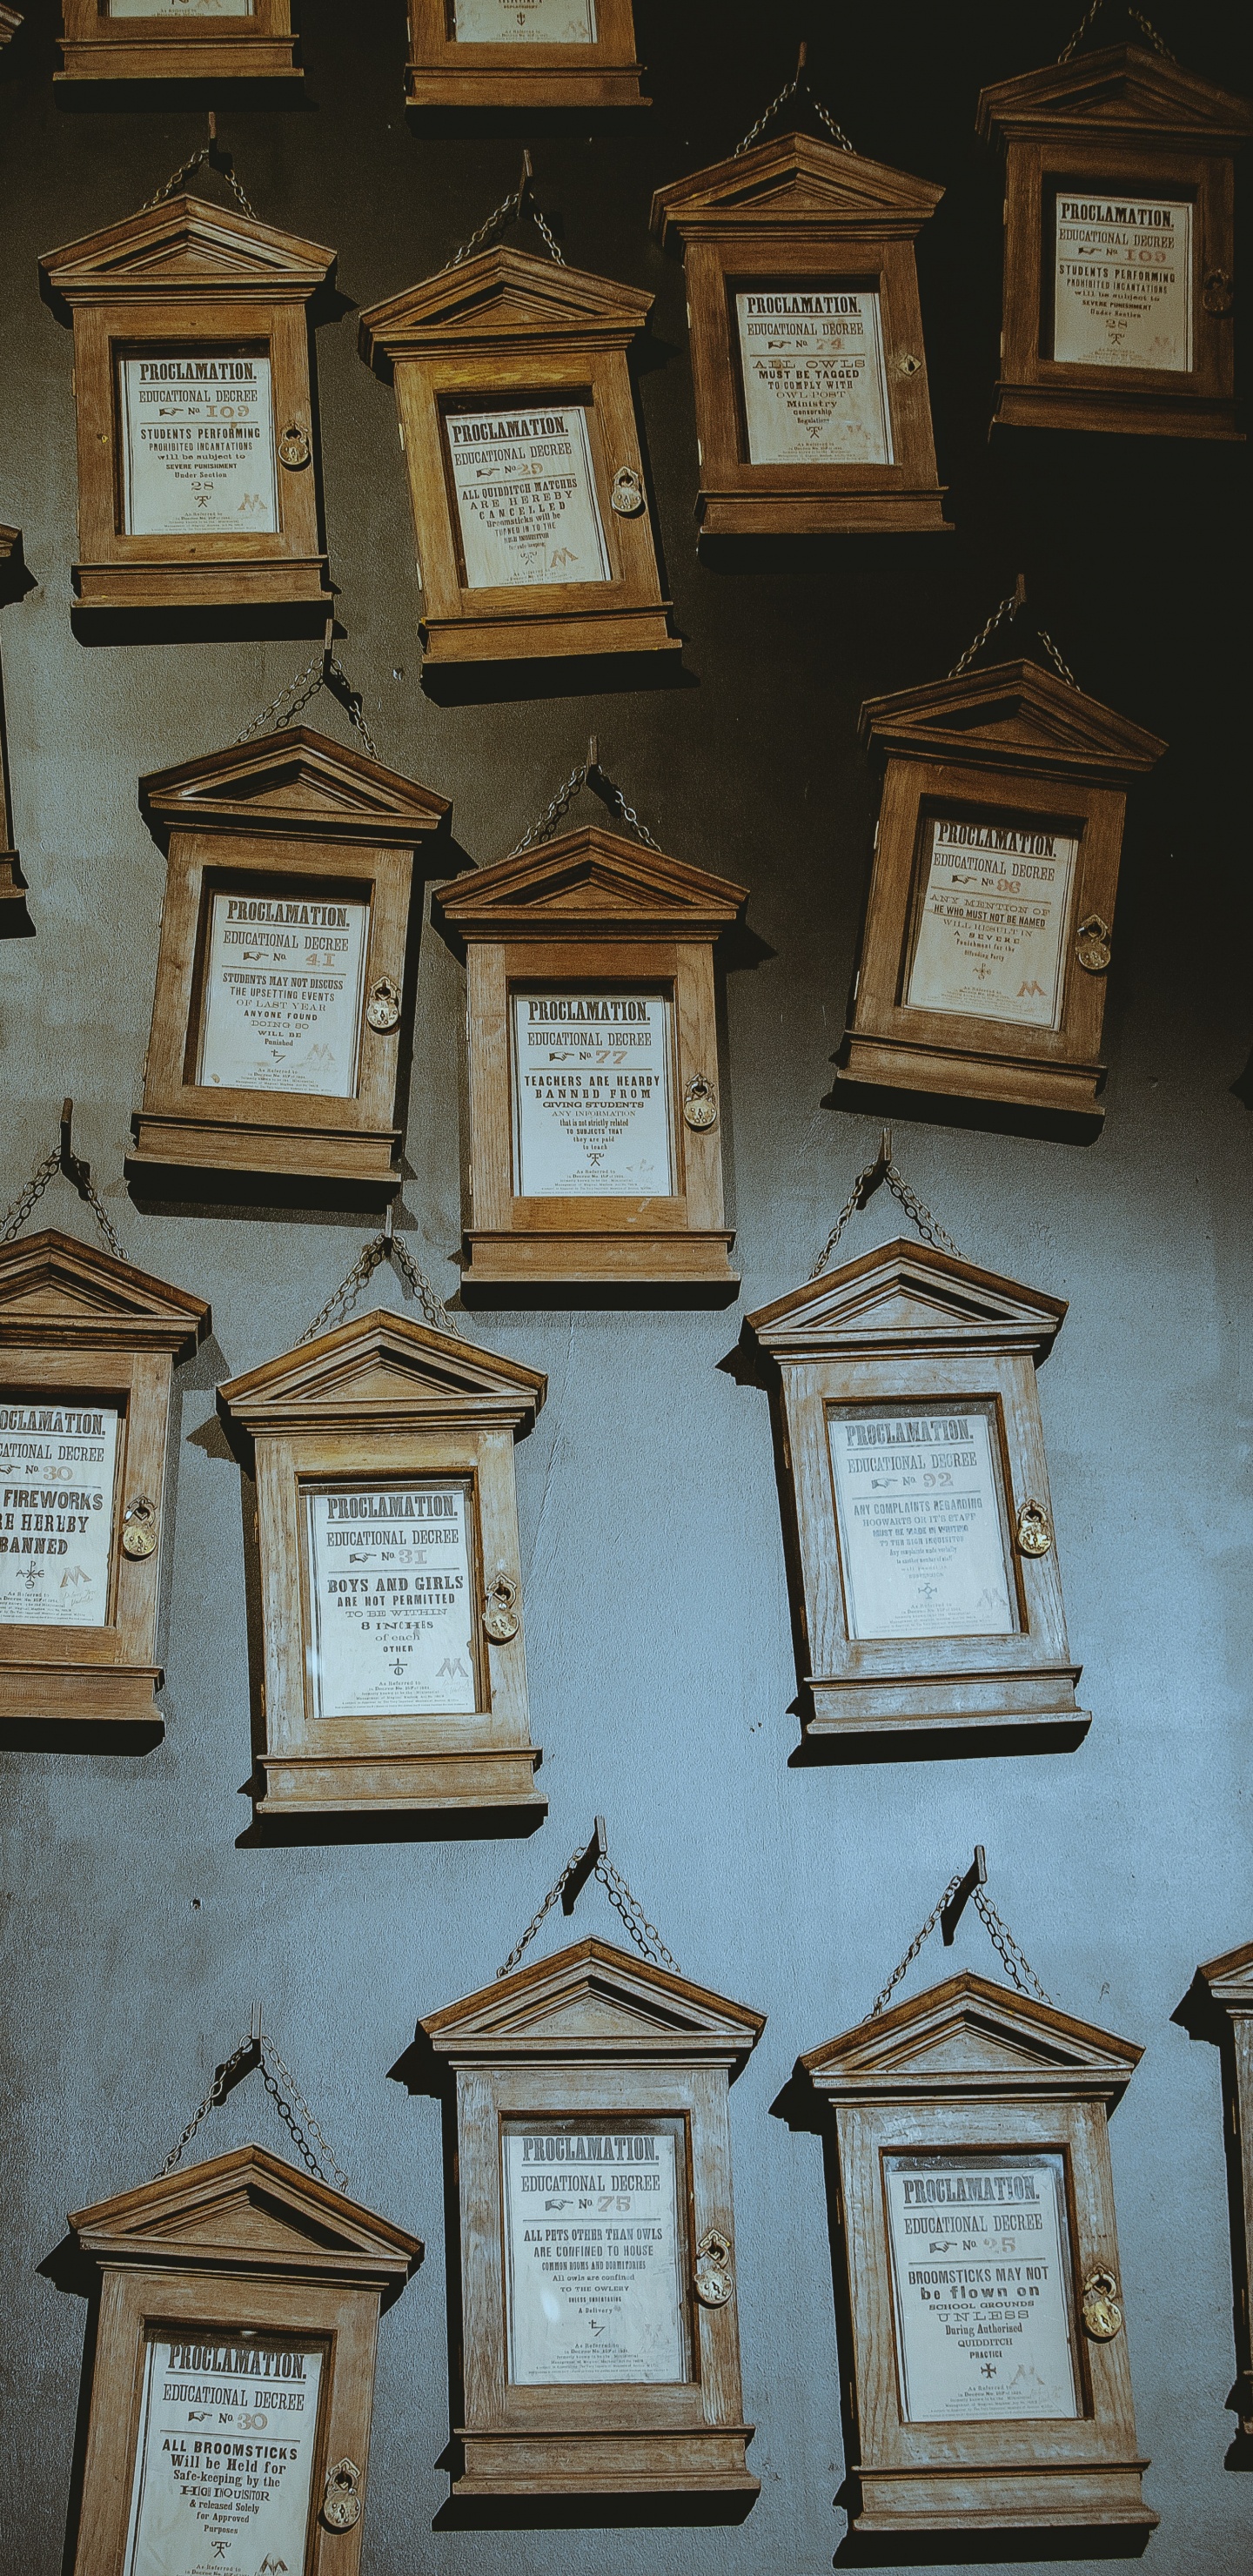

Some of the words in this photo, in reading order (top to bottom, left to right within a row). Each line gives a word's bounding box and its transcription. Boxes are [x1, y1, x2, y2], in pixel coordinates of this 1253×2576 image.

[1061, 202, 1174, 228] PROCLAMATION.
[1059, 228, 1129, 245] EDUCATIONAL
[1134, 234, 1175, 248] DECREE
[1059, 265, 1109, 278] STUDENTS
[1115, 269, 1175, 283] PERFORMING
[747, 297, 861, 313] PROCLAMATION.
[747, 323, 817, 335] EDUCATIONAL
[822, 323, 863, 335] DECREE
[139, 363, 257, 381] PROCLAMATION.
[753, 360, 795, 369] ALL
[806, 359, 865, 368] OWLS
[815, 370, 859, 379] TAGGED
[827, 380, 853, 389] WITH
[138, 391, 211, 403] EDUCATIONAL
[216, 390, 258, 402] DECREE
[141, 429, 191, 439] STUDENTS
[198, 428, 260, 439] PERFORMING
[452, 416, 568, 443] PROCLAMATION.
[149, 443, 193, 452] PROHIBITED
[198, 442, 252, 451] INCANTATIONS
[454, 447, 526, 466] EDUCATIONAL
[530, 443, 572, 458] DECREE
[191, 481, 214, 491] 28
[462, 490, 479, 500] ALL
[482, 484, 531, 499] QUIDDITCH
[534, 479, 578, 492] MATCHES
[471, 500, 499, 510] ARE
[509, 491, 573, 506] HEREBY
[479, 501, 566, 520] CANCELLED
[938, 822, 1056, 857] PROCLAMATION.
[933, 853, 1006, 875] EDUCATIONAL
[1012, 863, 1055, 881] DECREE
[227, 900, 350, 927] PROCLAMATION.
[934, 904, 943, 913] HE
[947, 906, 964, 916] WHO
[966, 909, 987, 919] MUST
[989, 914, 1004, 922] NOT
[1007, 916, 1016, 924] BE
[1019, 916, 1046, 927] NAMED
[224, 930, 298, 949] EDUCATIONAL
[305, 936, 348, 951] DECREE
[223, 973, 267, 985] STUDENTS
[269, 976, 288, 987] MAY
[291, 978, 307, 988] NOT
[310, 979, 344, 990] DISCUSS
[231, 987, 246, 996] THE
[251, 989, 298, 1000] UPSETTING
[302, 992, 335, 1002] EVENTS
[256, 1001, 288, 1010] LAST
[528, 1001, 650, 1021] PROCLAMATION.
[245, 1010, 282, 1019] ANYONE
[527, 1032, 602, 1046] EDUCATIONAL
[608, 1033, 651, 1046] DECREE
[596, 1050, 627, 1064] 77
[525, 1076, 581, 1086] TEACHERS
[589, 1076, 609, 1086] ARE
[617, 1076, 660, 1086] HEARBY
[536, 1090, 600, 1098] BANNED
[610, 1089, 651, 1098] FROM
[588, 1118, 608, 1128] strictly
[0, 1410, 105, 1436] OCLAMATION.
[846, 1419, 973, 1447] PROCLAMATION.
[58, 1446, 104, 1462] DECREE
[847, 1455, 926, 1473] EDUCATIONAL
[930, 1452, 977, 1469] DECREE
[44, 1466, 73, 1480] 30
[3, 1490, 103, 1511] FIREWORKS
[327, 1494, 458, 1519] PROCLAMATION.
[854, 1505, 870, 1516] ANY
[874, 1501, 930, 1515] COMPLAINTS
[863, 1517, 911, 1526] HOGWARTS
[0, 1537, 68, 1555] BANNED
[327, 1531, 406, 1546] EDUCATIONAL
[412, 1530, 459, 1544] DECREE
[328, 1579, 368, 1593] BOYS
[376, 1578, 408, 1591] AND
[415, 1576, 464, 1590] GIRLS
[338, 1597, 358, 1607] ARE
[365, 1596, 385, 1607] NOT
[393, 1594, 455, 1605] PERMITTED
[523, 2137, 660, 2161] PROCLAMATION.
[521, 2175, 605, 2192] EDUCATIONAL
[611, 2175, 660, 2191] DECREE
[903, 2176, 1040, 2204] PROCLAMATION.
[904, 2216, 988, 2234] EDUCATIONAL
[994, 2214, 1042, 2231] DECREE
[524, 2230, 542, 2241] ALL
[546, 2230, 569, 2241] PETS
[572, 2229, 603, 2241] OTHER
[606, 2228, 633, 2240] THAN
[636, 2228, 662, 2240] OWLS
[534, 2246, 552, 2257] ARE
[556, 2246, 603, 2257] CONFINED
[608, 2246, 620, 2256] TO
[624, 2245, 653, 2256] HOUSE
[908, 2268, 991, 2284] BROOMSTICKS
[996, 2268, 1021, 2282] MAY
[1026, 2266, 1049, 2280] NOT
[921, 2287, 940, 2300] be
[950, 2287, 1008, 2298] flown
[1016, 2286, 1040, 2296] on
[937, 2311, 1029, 2322] UNLESS
[945, 2325, 975, 2337] During
[977, 2323, 1022, 2334] Authorised
[957, 2338, 1013, 2347] QUIDDITCH
[168, 2345, 306, 2379] PROCLAMATION.
[163, 2384, 248, 2407] EDUCATIONAL
[254, 2392, 304, 2411] DECREE
[238, 2412, 267, 2430] 30
[162, 2438, 187, 2452] ALL
[194, 2441, 298, 2459] BROOMSTICKS
[171, 2454, 198, 2468] Will
[206, 2456, 220, 2469] be
[227, 2459, 258, 2472] Held
[265, 2461, 285, 2475] for
[174, 2470, 242, 2487] Safe-keeping
[247, 2475, 258, 2487] by
[264, 2477, 280, 2487] the
[198, 2500, 232, 2511] released
[235, 2503, 259, 2513] Solely
[212, 2512, 250, 2523] Approved
[204, 2525, 238, 2534] Purposes
